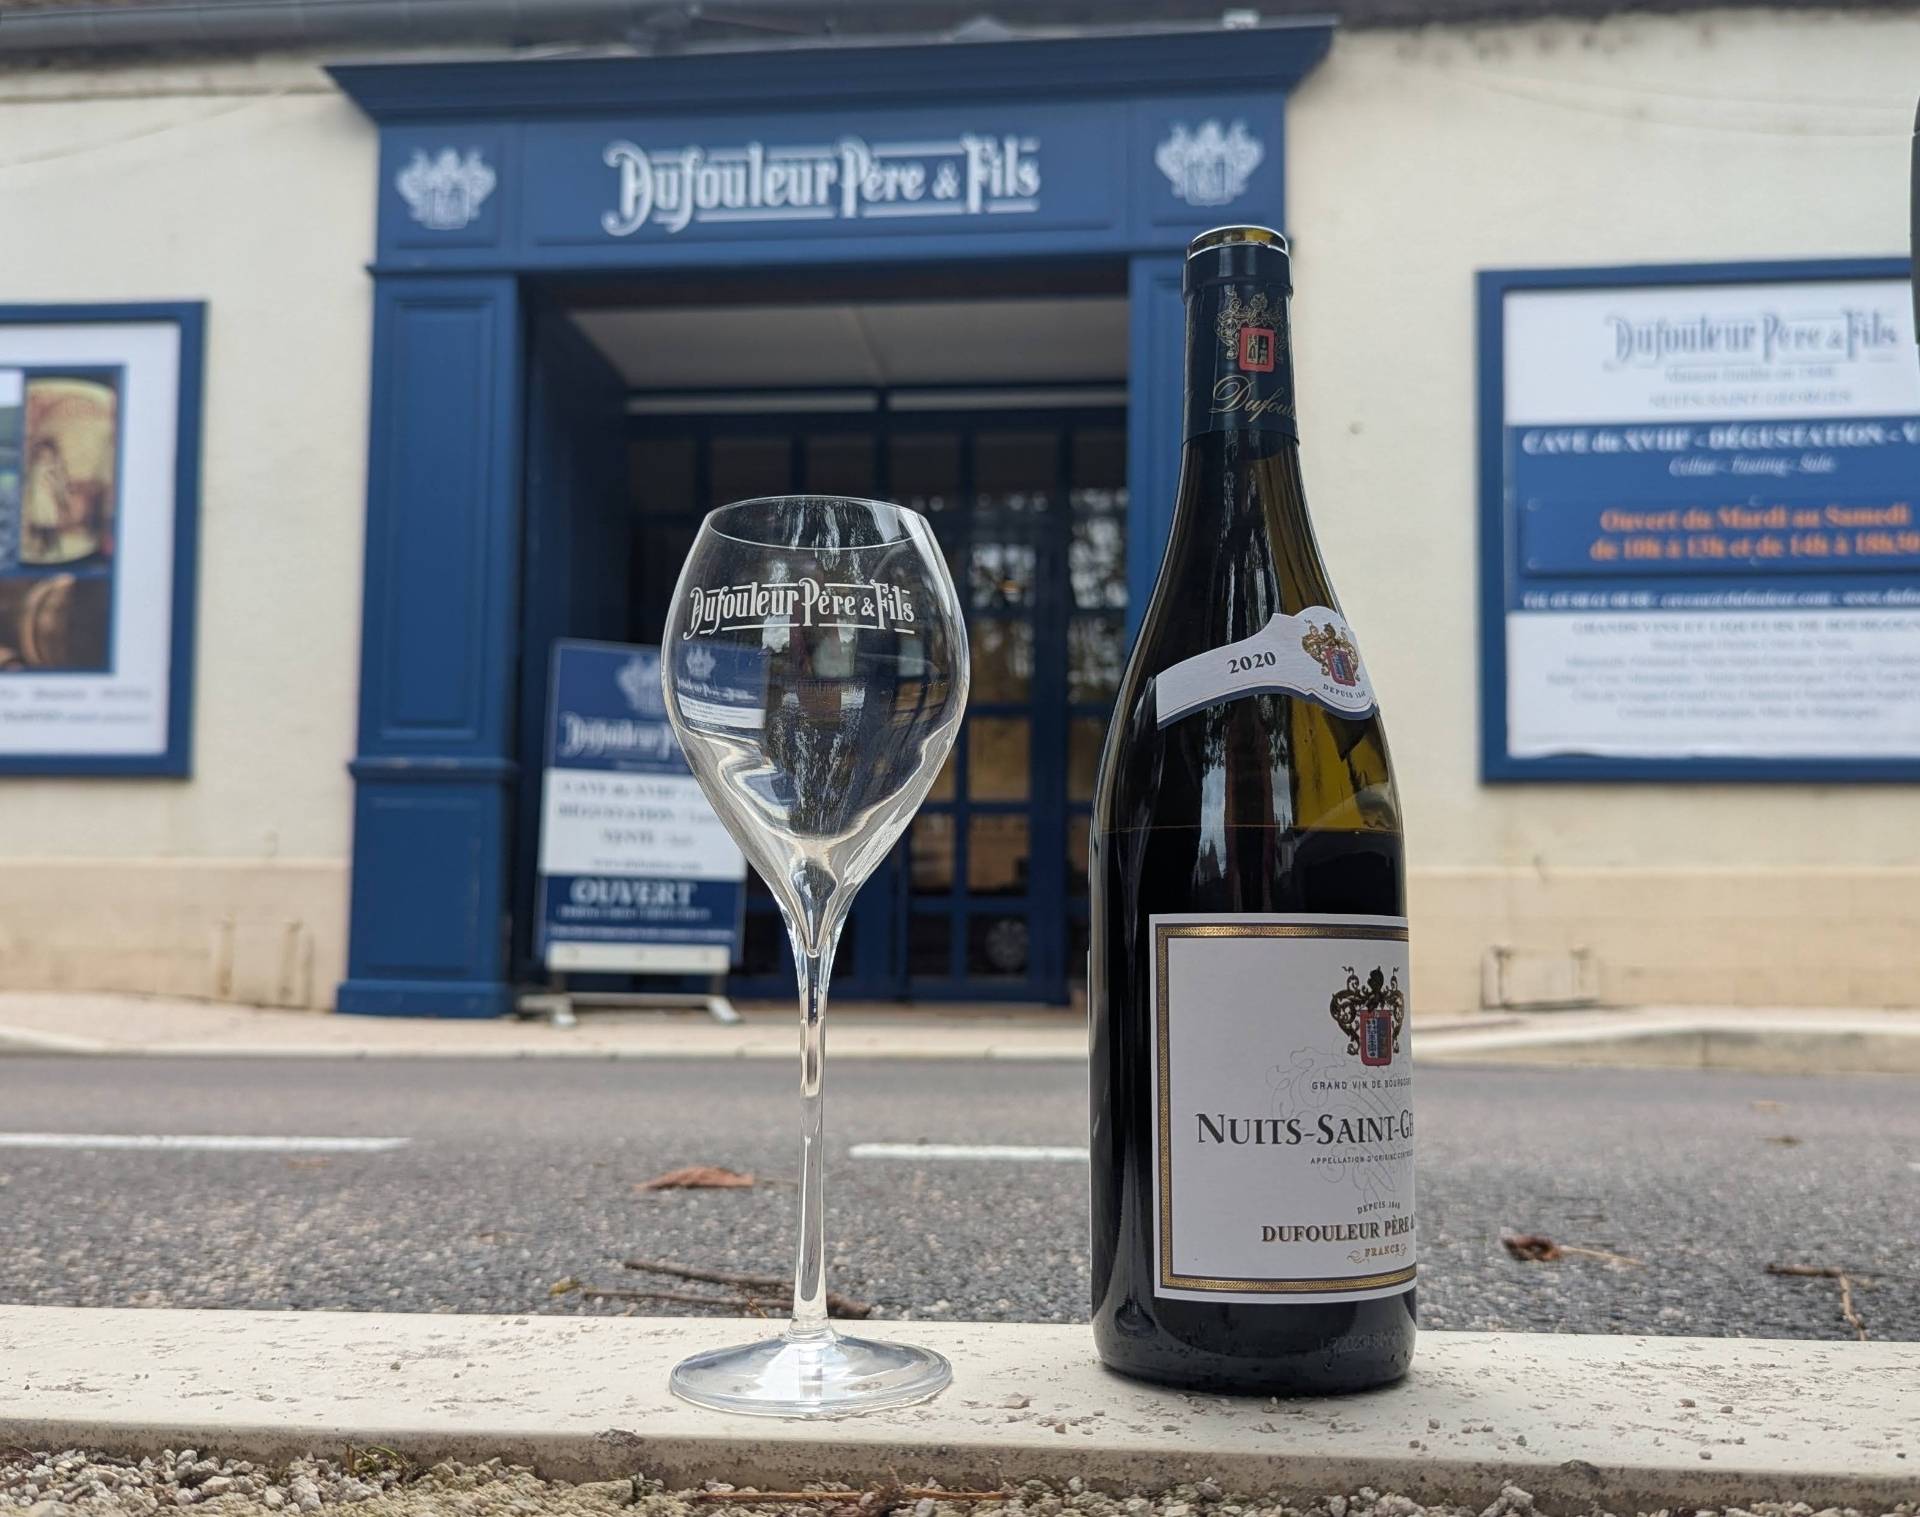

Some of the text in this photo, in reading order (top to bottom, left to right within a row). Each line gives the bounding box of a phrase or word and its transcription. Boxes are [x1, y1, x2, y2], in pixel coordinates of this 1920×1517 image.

[601, 133, 1041, 236] Dufouleur Père & Fils
[1603, 314, 1756, 370] Dufouleur
[1842, 308, 1898, 362] Fils
[1522, 430, 1590, 455] CAVE
[1592, 432, 1622, 453] du
[1708, 423, 1887, 450] DÉGUSTATION
[1600, 503, 1911, 533] Ouvert du Mardi au Samedi
[1590, 539, 1618, 561] de
[1729, 538, 1752, 558] et
[1755, 535, 1785, 558] de
[683, 577, 915, 640] Dufouleur Père & Fils
[1227, 651, 1276, 674] 2020
[1322, 683, 1354, 699] DEPUIS
[569, 877, 698, 906] OUVERT
[1311, 1080, 1348, 1091] GRAND
[1352, 1080, 1367, 1090] VIN
[1371, 1080, 1382, 1089] DE
[1310, 1156, 1365, 1165] APPELLATION
[1357, 1200, 1386, 1214] DEPUIS
[1261, 1222, 1381, 1242] DUFOULEUR
[1384, 1214, 1409, 1237] PÈRE
[1364, 1244, 1400, 1258] FRANCE
